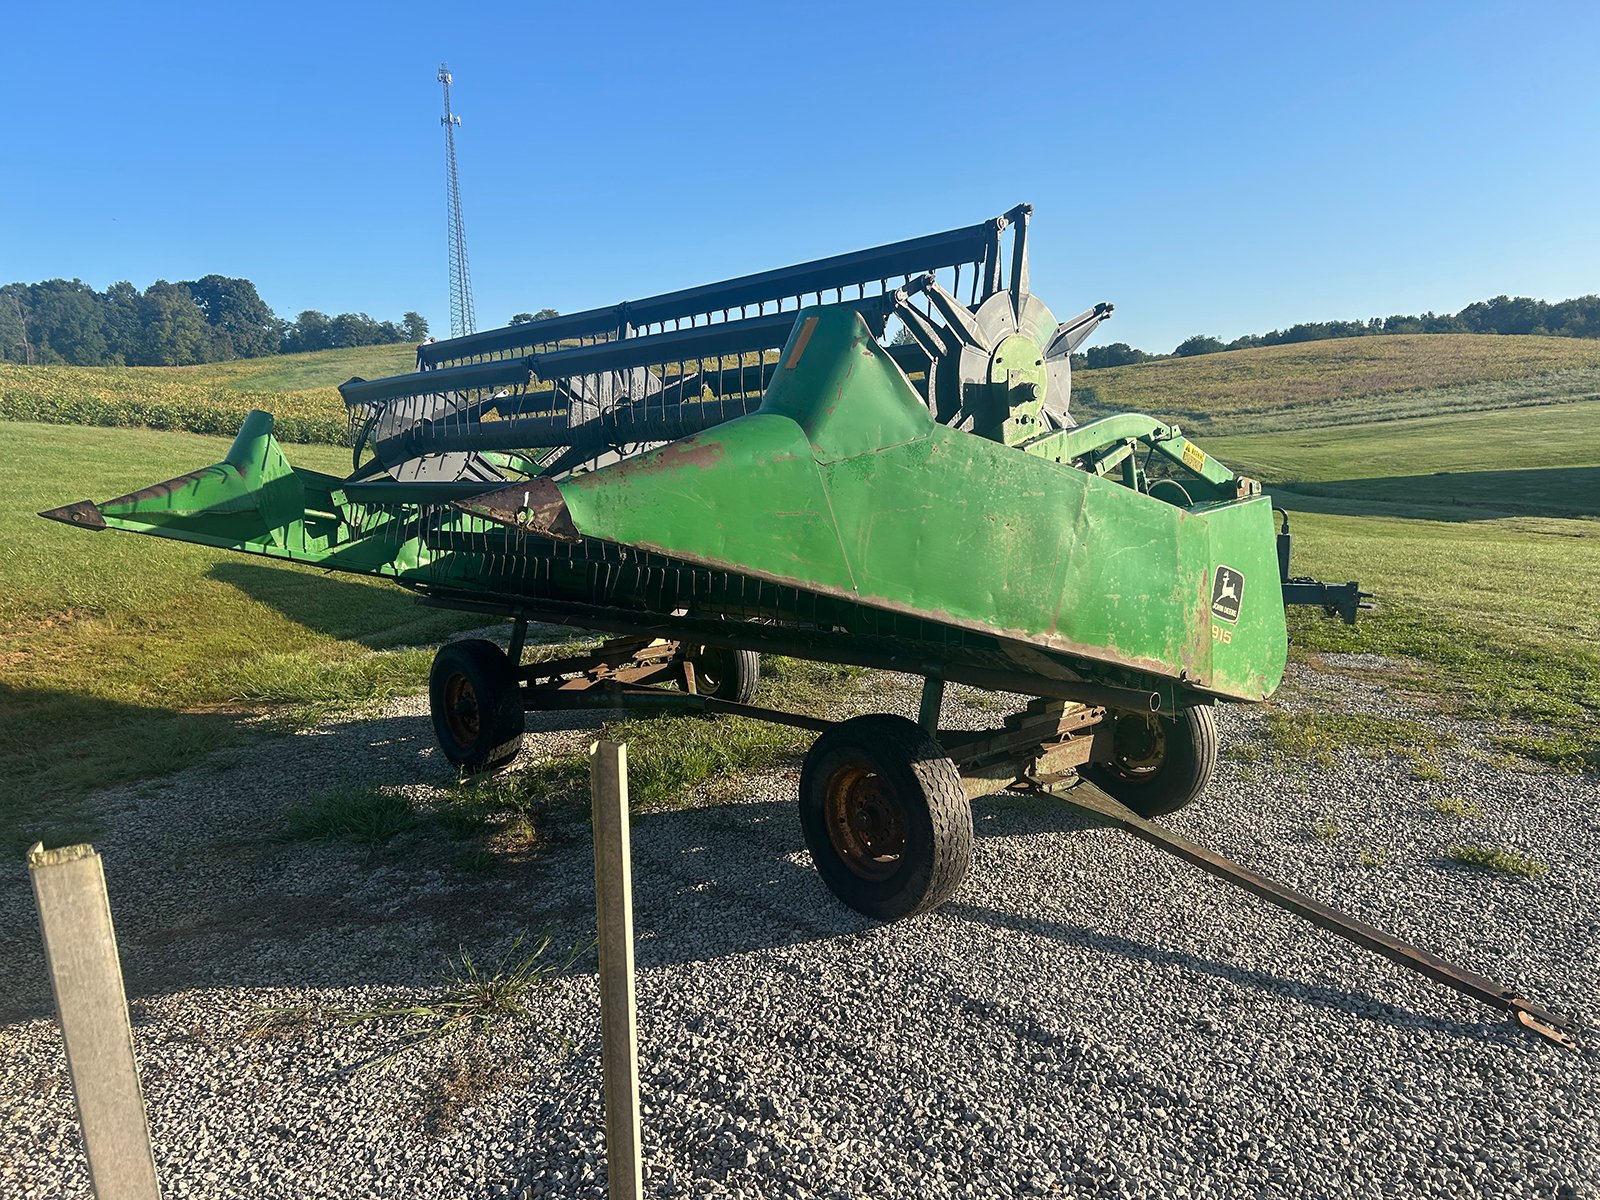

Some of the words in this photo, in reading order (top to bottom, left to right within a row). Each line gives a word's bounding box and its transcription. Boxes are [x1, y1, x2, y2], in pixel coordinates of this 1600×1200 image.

[1212, 602, 1223, 612] JOHN
[1224, 606, 1237, 617] DEERE
[1212, 625, 1232, 644] 915
